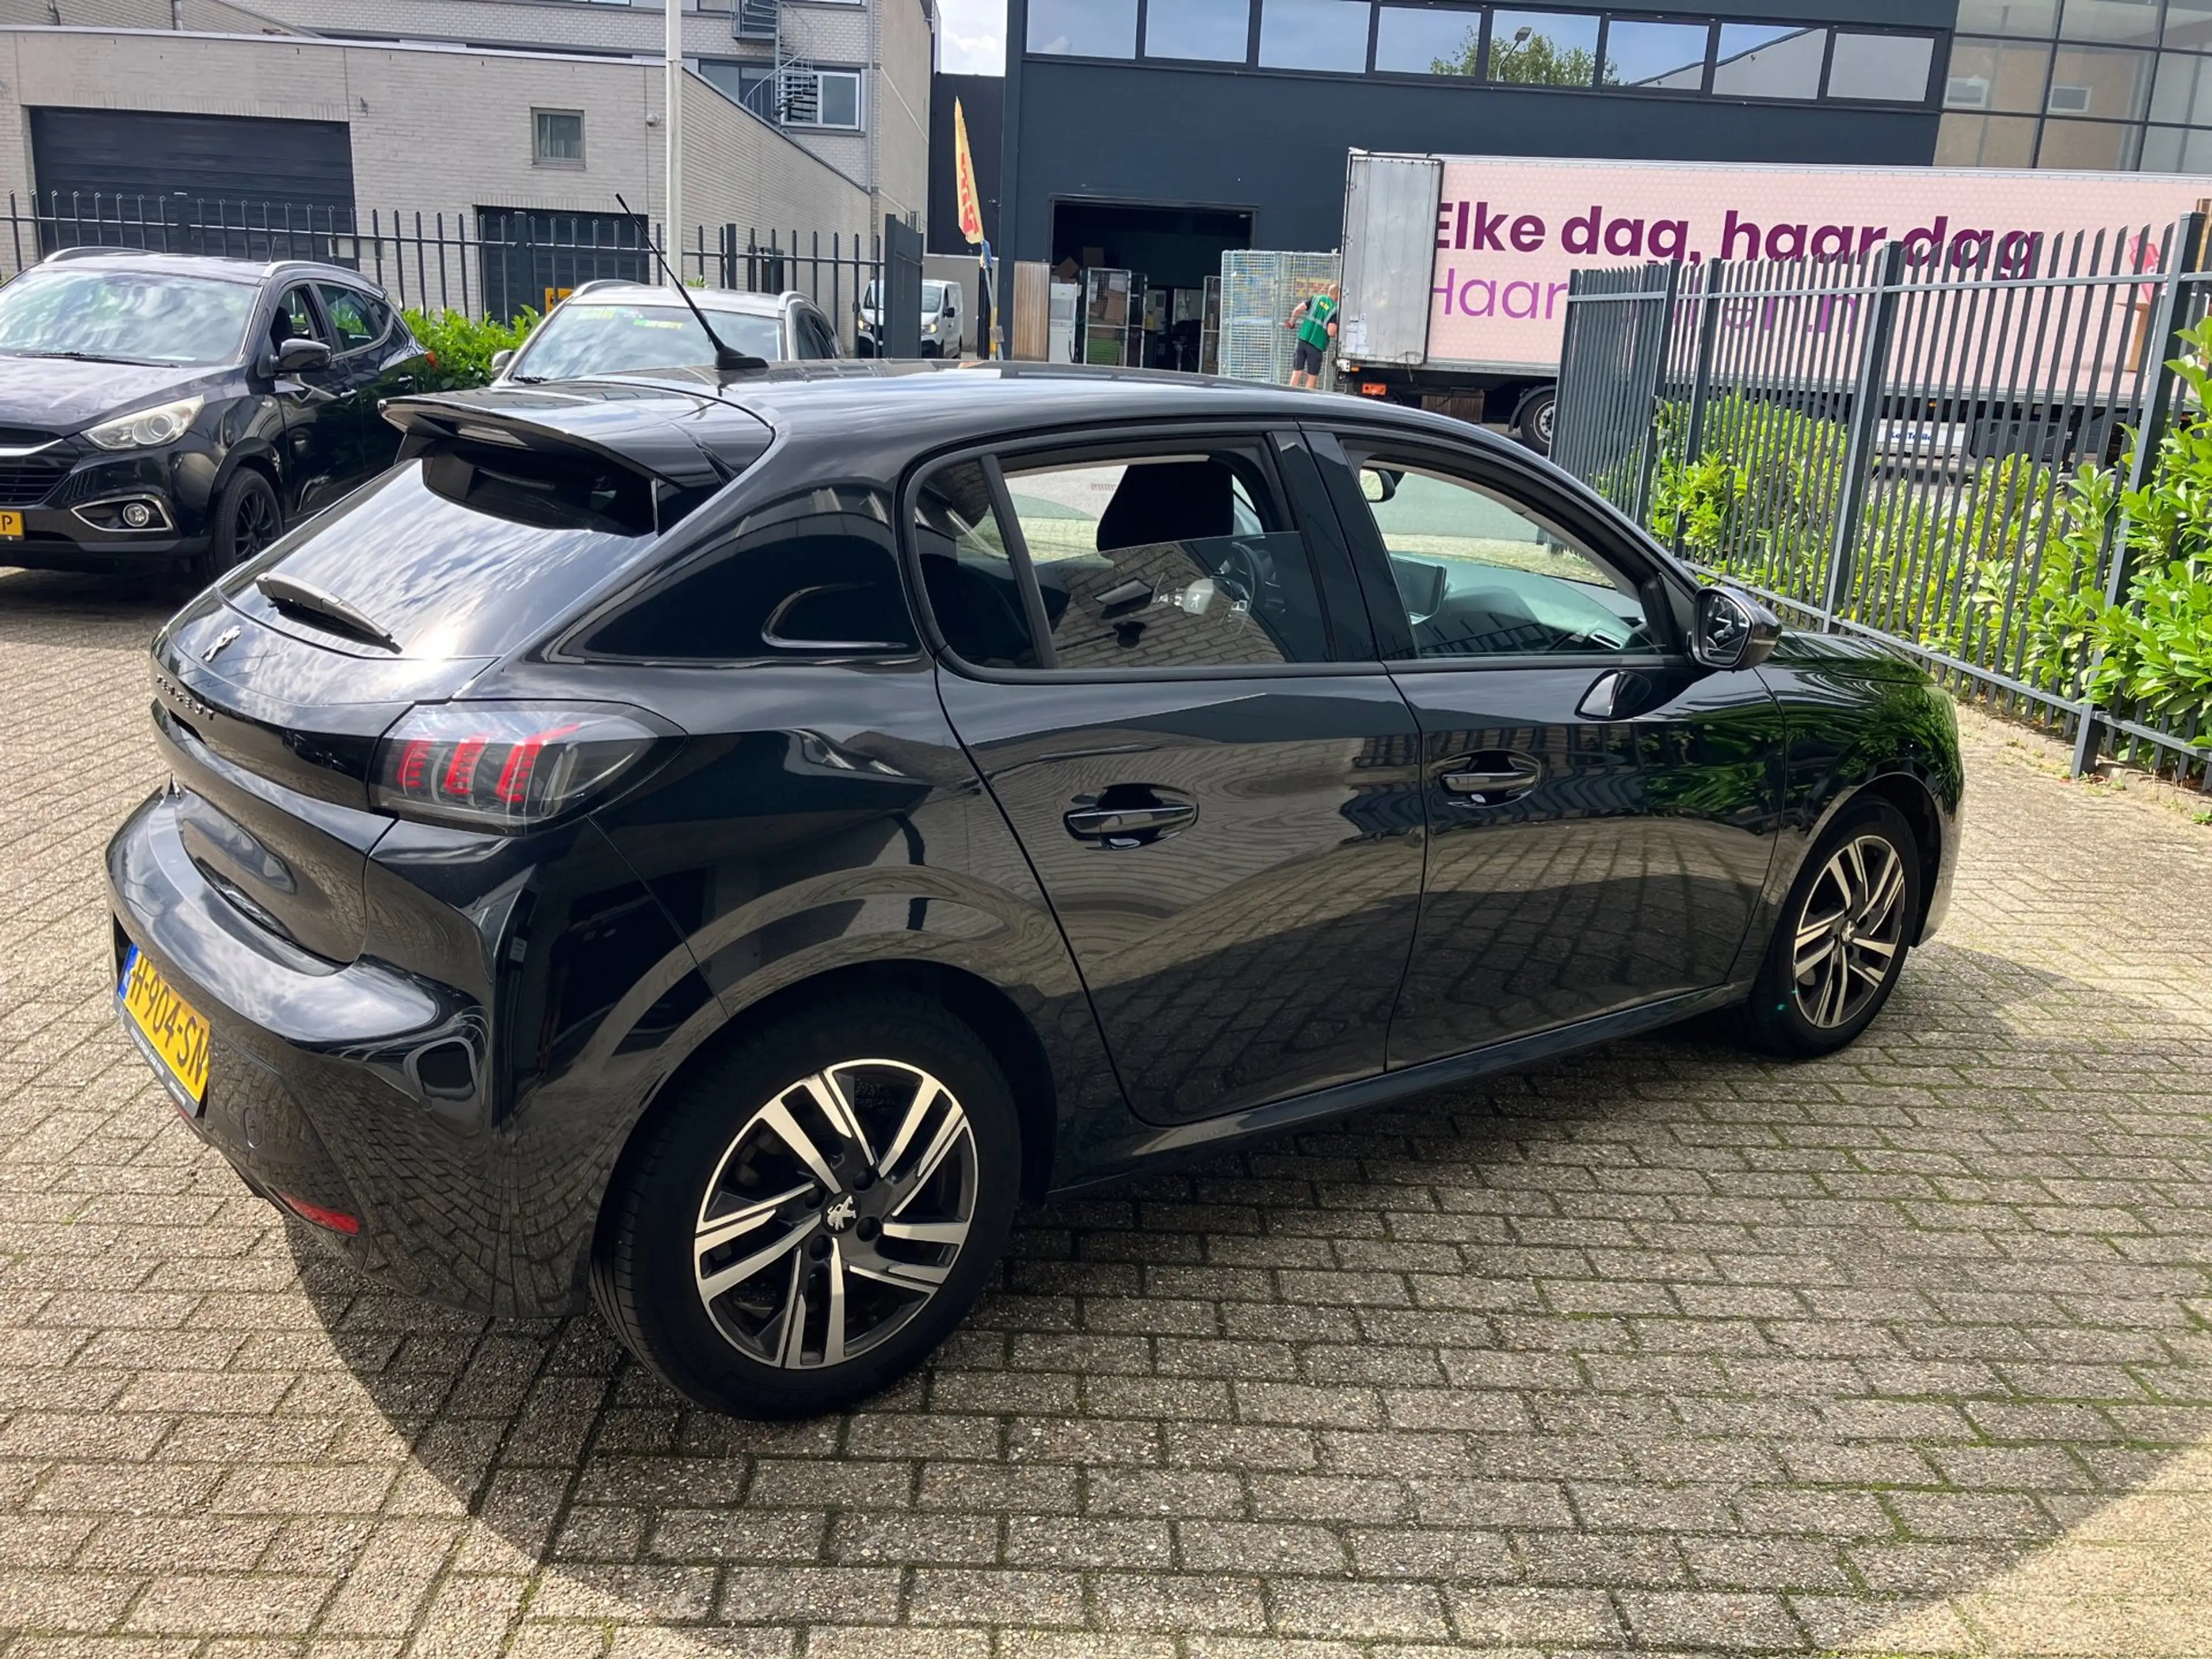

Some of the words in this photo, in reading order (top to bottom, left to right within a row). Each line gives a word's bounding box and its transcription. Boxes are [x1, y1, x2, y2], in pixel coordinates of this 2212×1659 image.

[1436, 201, 1546, 252] Elke
[1561, 206, 1701, 268] dag,
[1720, 210, 1888, 266] haar
[1900, 215, 2045, 281] dag
